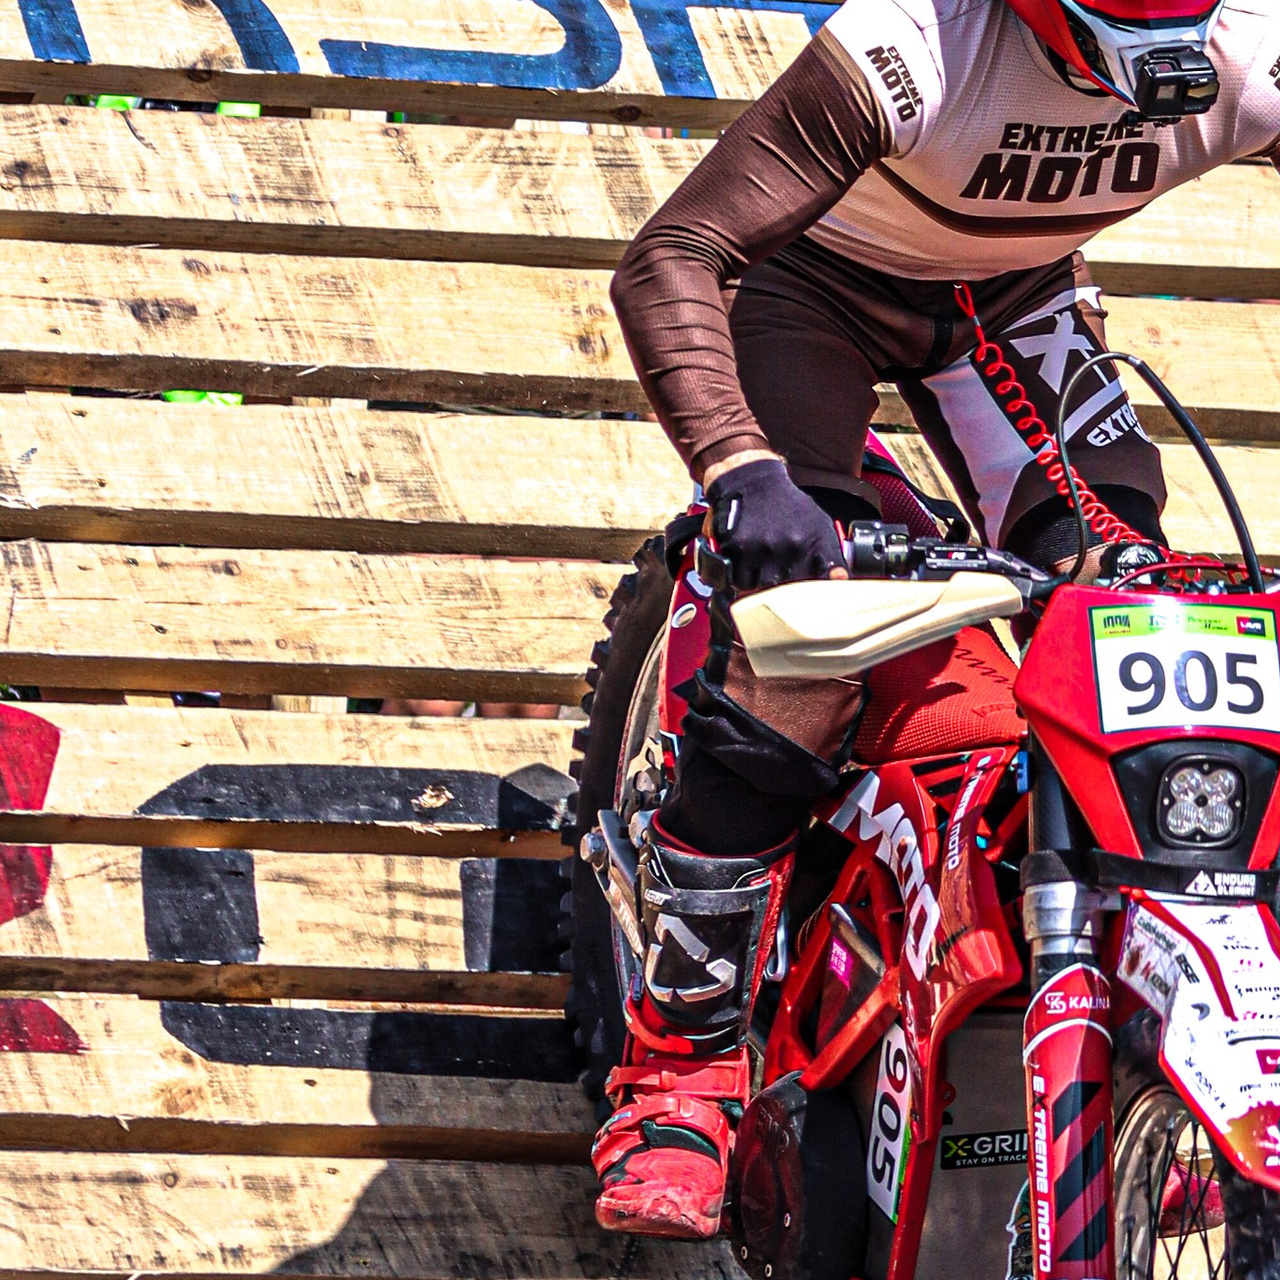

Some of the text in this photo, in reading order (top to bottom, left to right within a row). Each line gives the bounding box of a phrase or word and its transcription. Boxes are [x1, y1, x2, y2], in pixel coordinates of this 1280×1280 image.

[864, 45, 917, 123] MOTO
[886, 45, 923, 108] EXTREME
[998, 122, 1144, 154] EXTREME
[959, 141, 1160, 203] MOTO
[1118, 650, 1265, 715] 905
[1214, 873, 1256, 886] ENDURO
[872, 1039, 907, 1193] 905
[956, 1158, 978, 1166] STAY
[998, 1154, 1027, 1162] TRACK
[1032, 1075, 1051, 1273] EXTREME MOTO
